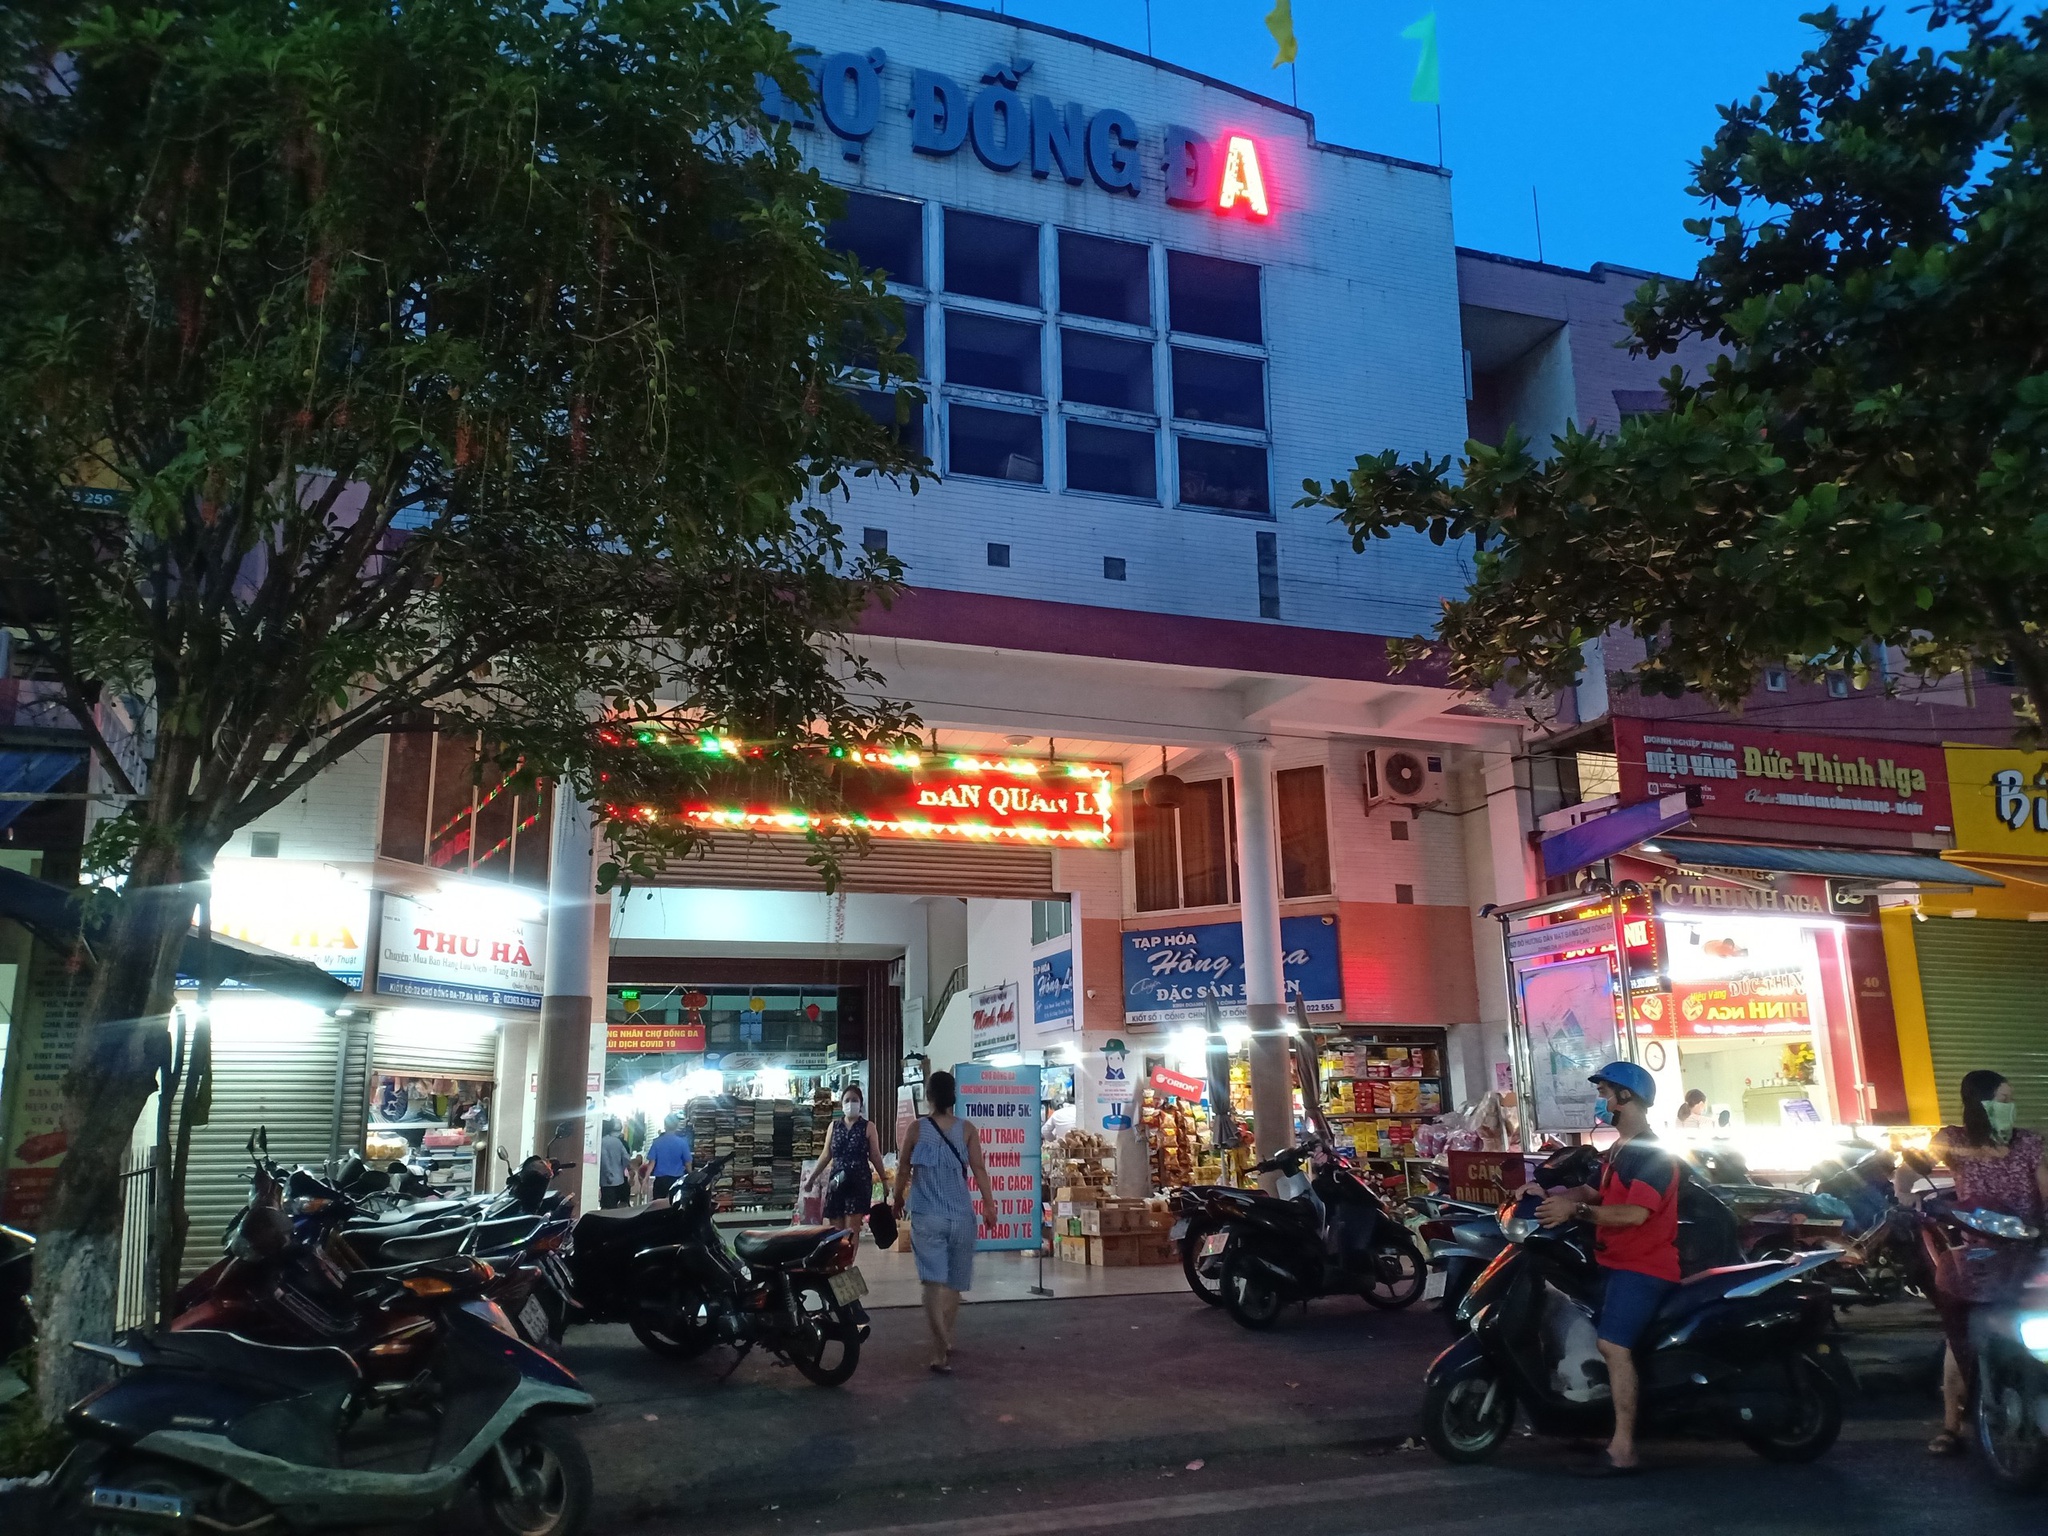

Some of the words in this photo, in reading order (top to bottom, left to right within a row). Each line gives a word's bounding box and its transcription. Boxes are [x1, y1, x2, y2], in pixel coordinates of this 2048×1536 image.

[908, 60, 1141, 198] ĐỐNG
[1162, 122, 1270, 222] ĐA
[1646, 747, 1688, 779] HIỆU
[1743, 746, 1794, 780] Đức
[1797, 751, 1876, 793] Thịnh
[1878, 758, 1926, 798] Nga
[1640, 875, 1684, 906] ỨC
[1783, 893, 1824, 914] NGA
[413, 928, 480, 958] THU
[490, 939, 532, 967] HÀ
[1132, 936, 1161, 951] TẠP
[1164, 931, 1197, 947] HÓA
[1147, 948, 1232, 980] Hồng
[1864, 976, 1880, 988] 40
[1157, 984, 1193, 1003] ĐẶC
[1132, 1011, 1146, 1022] KIỐT
[1148, 1010, 1158, 1020] SỐ
[1306, 1004, 1320, 1012] 022
[1321, 1003, 1335, 1011] 555
[620, 1028, 643, 1038] NHÂN
[645, 1030, 662, 1040] CHỢ
[663, 1027, 686, 1038] ĐỐNG
[687, 1030, 699, 1038] ĐA
[619, 1040, 638, 1050] DỊCH
[640, 1040, 663, 1048] COVID
[665, 1040, 676, 1048] 19
[1166, 1077, 1195, 1093] ORION
[966, 1101, 995, 1118] THÔNG
[997, 1101, 1016, 1120] ĐIỆP
[1018, 1103, 1032, 1118] 5K:
[995, 1128, 1025, 1144] TRANG
[989, 1146, 1021, 1168] KHUẨN
